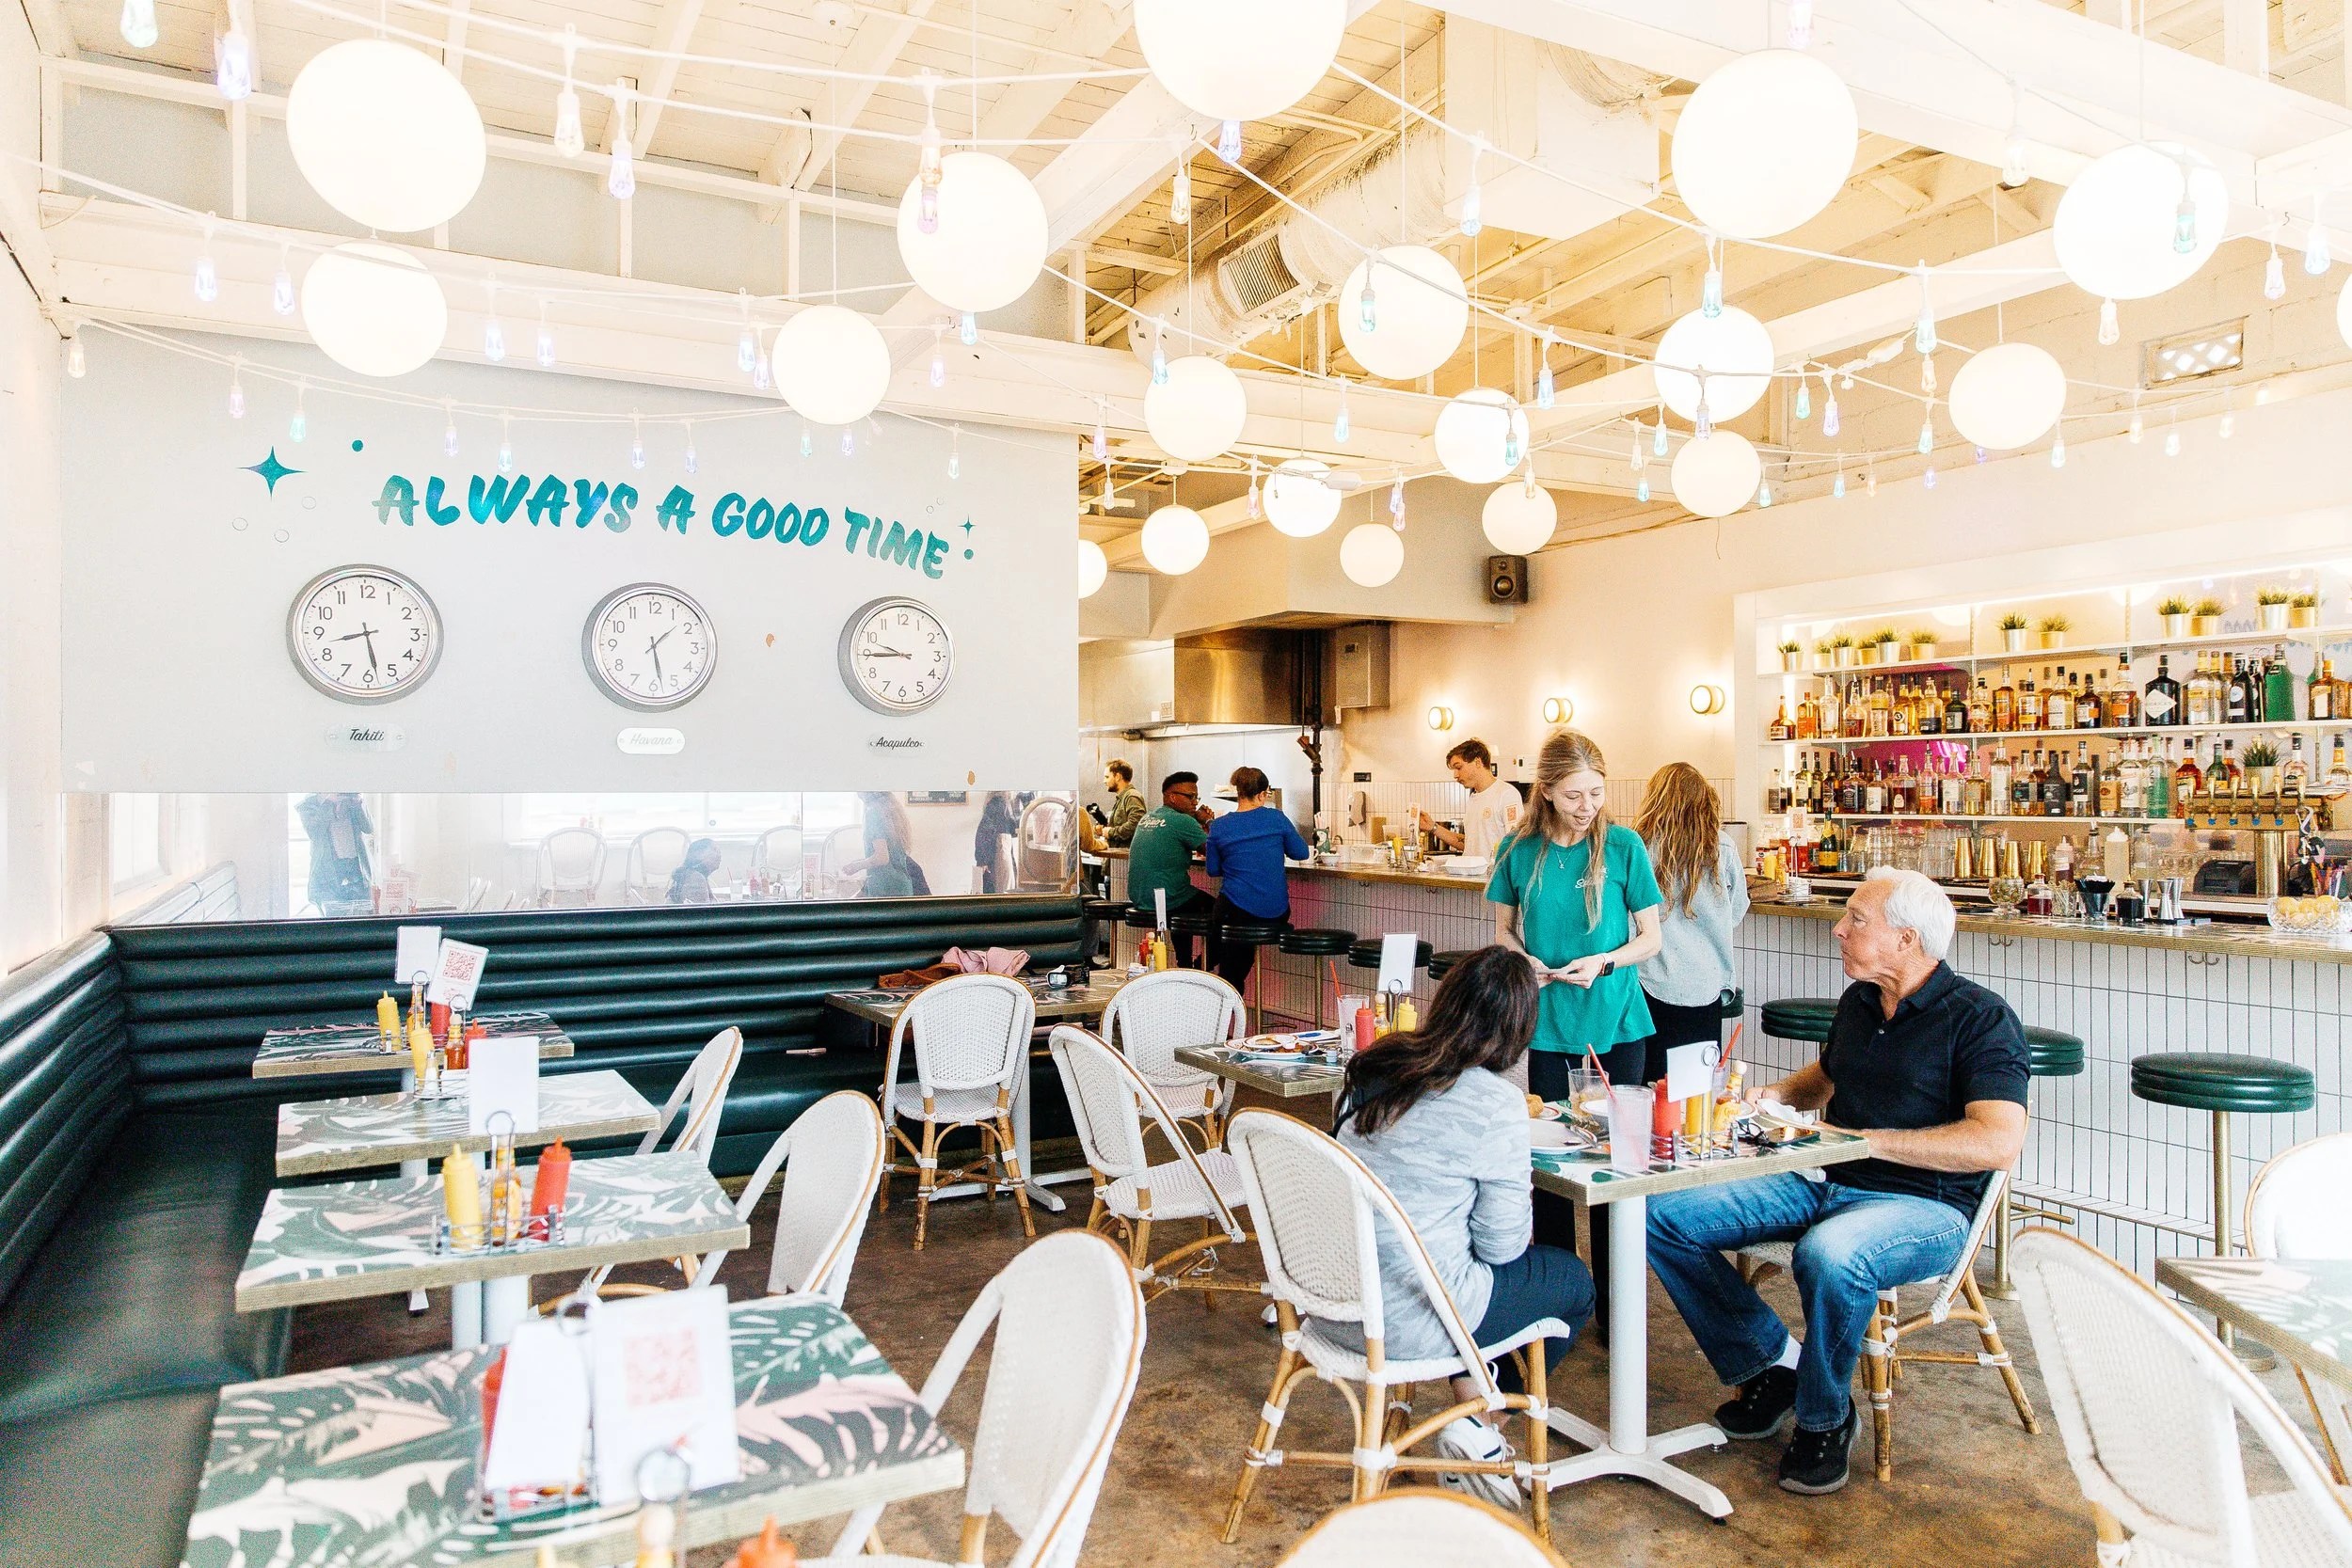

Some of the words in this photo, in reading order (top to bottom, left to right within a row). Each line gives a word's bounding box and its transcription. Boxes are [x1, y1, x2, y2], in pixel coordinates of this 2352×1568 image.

[372, 473, 639, 533] ALWAYS
[656, 484, 695, 534] A
[712, 492, 830, 546] GOOD
[845, 506, 949, 579] TIME
[337, 591, 346, 605] 11
[359, 584, 376, 599] 12
[318, 606, 333, 620] 10
[401, 607, 412, 620] 2
[628, 607, 637, 620] 11
[648, 601, 662, 614] 12
[880, 618, 887, 630] 11
[898, 613, 909, 626] 12
[612, 620, 626, 633] 10
[683, 622, 692, 635] 2
[312, 626, 325, 641] 9
[410, 627, 421, 641] 3
[866, 631, 878, 643] 10
[927, 633, 935, 644] 2
[608, 639, 618, 652] 9
[691, 641, 699, 655] 3
[322, 647, 333, 661] 8
[402, 648, 414, 661] 4
[863, 648, 872, 660] 9
[933, 651, 941, 663] 3
[341, 663, 352, 677] 7
[387, 663, 398, 677] 5
[614, 658, 624, 672] 8
[683, 660, 693, 673] 4
[362, 669, 373, 683] 6
[630, 673, 641, 686] 7
[868, 667, 877, 679] 8
[927, 668, 935, 679] 4
[648, 679, 659, 692] 6
[670, 674, 678, 687] 5
[882, 681, 891, 692] 7
[915, 681, 924, 693] 5
[898, 686, 907, 697] 6
[348, 728, 385, 741] Tahiti
[628, 733, 674, 746] Havana
[875, 736, 920, 750] Acapulco
